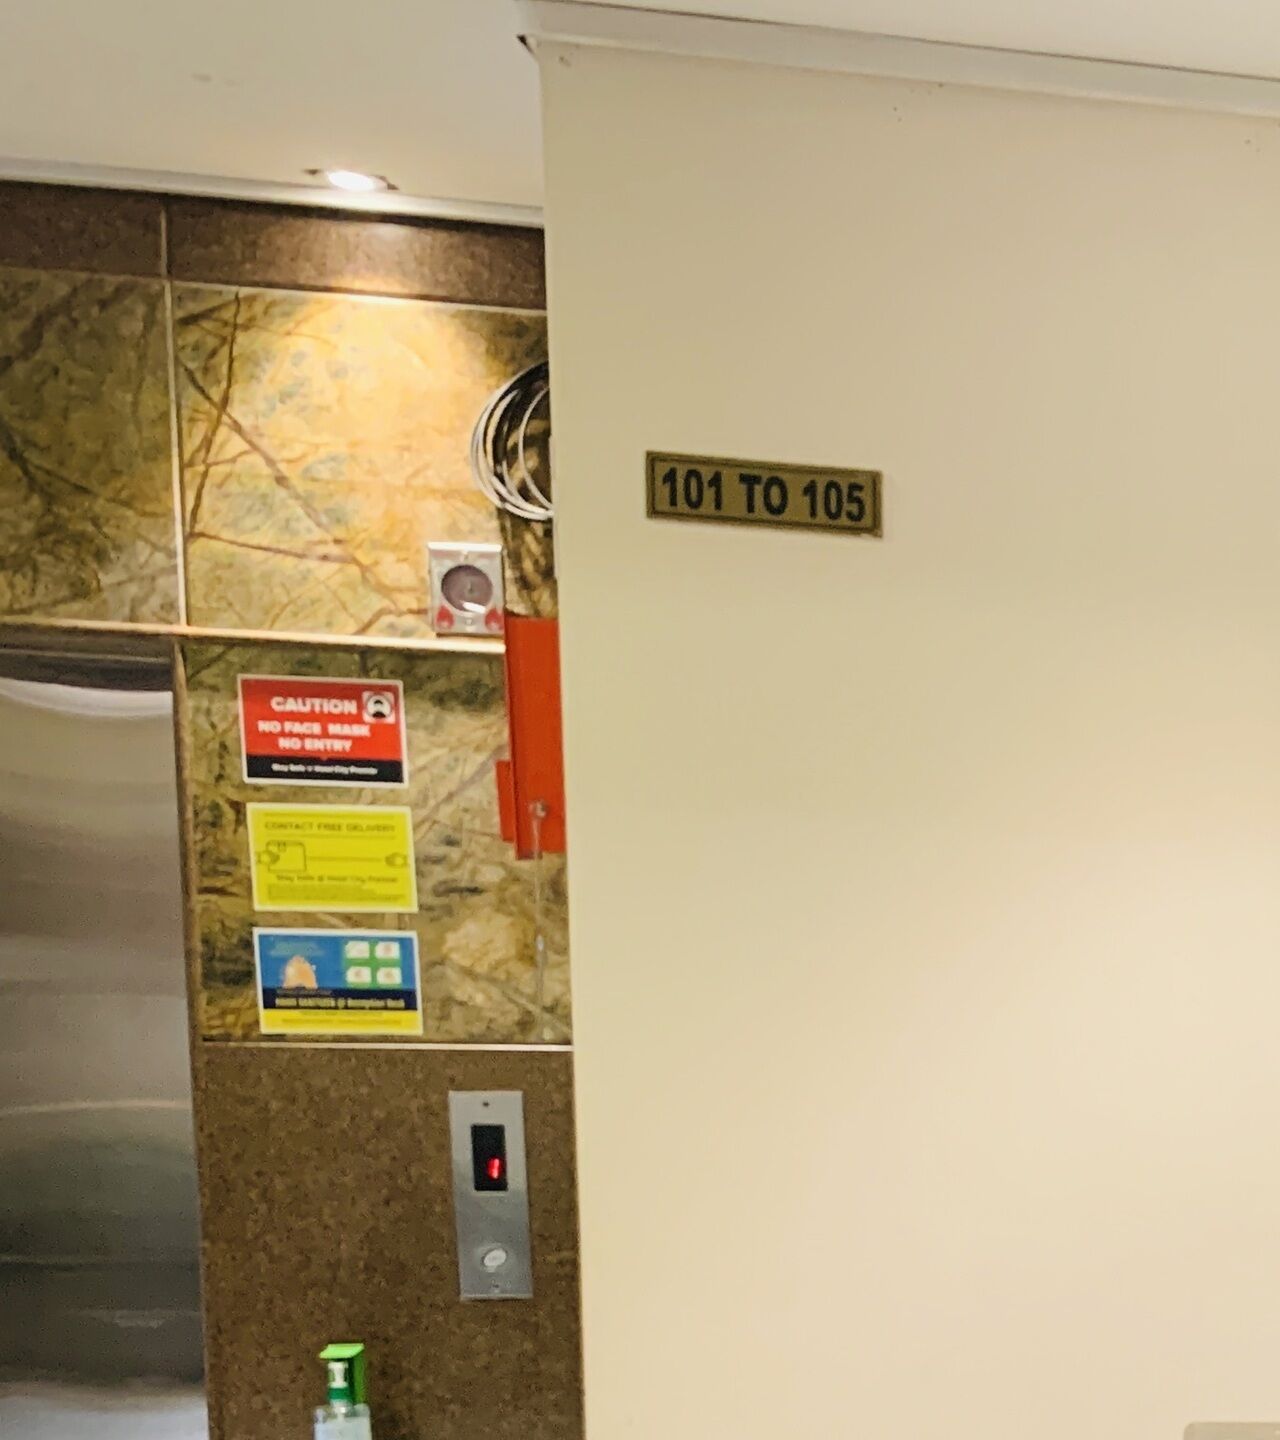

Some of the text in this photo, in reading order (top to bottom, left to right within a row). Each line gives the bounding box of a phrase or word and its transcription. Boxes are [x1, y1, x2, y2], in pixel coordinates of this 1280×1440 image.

[662, 467, 865, 522] 101 TO 105
[271, 696, 358, 715] CAUTION
[257, 720, 371, 737] NO FACE MASK
[278, 737, 352, 752] NO ENTRY
[265, 821, 313, 831] CONTACT
[317, 822, 341, 832] FREE
